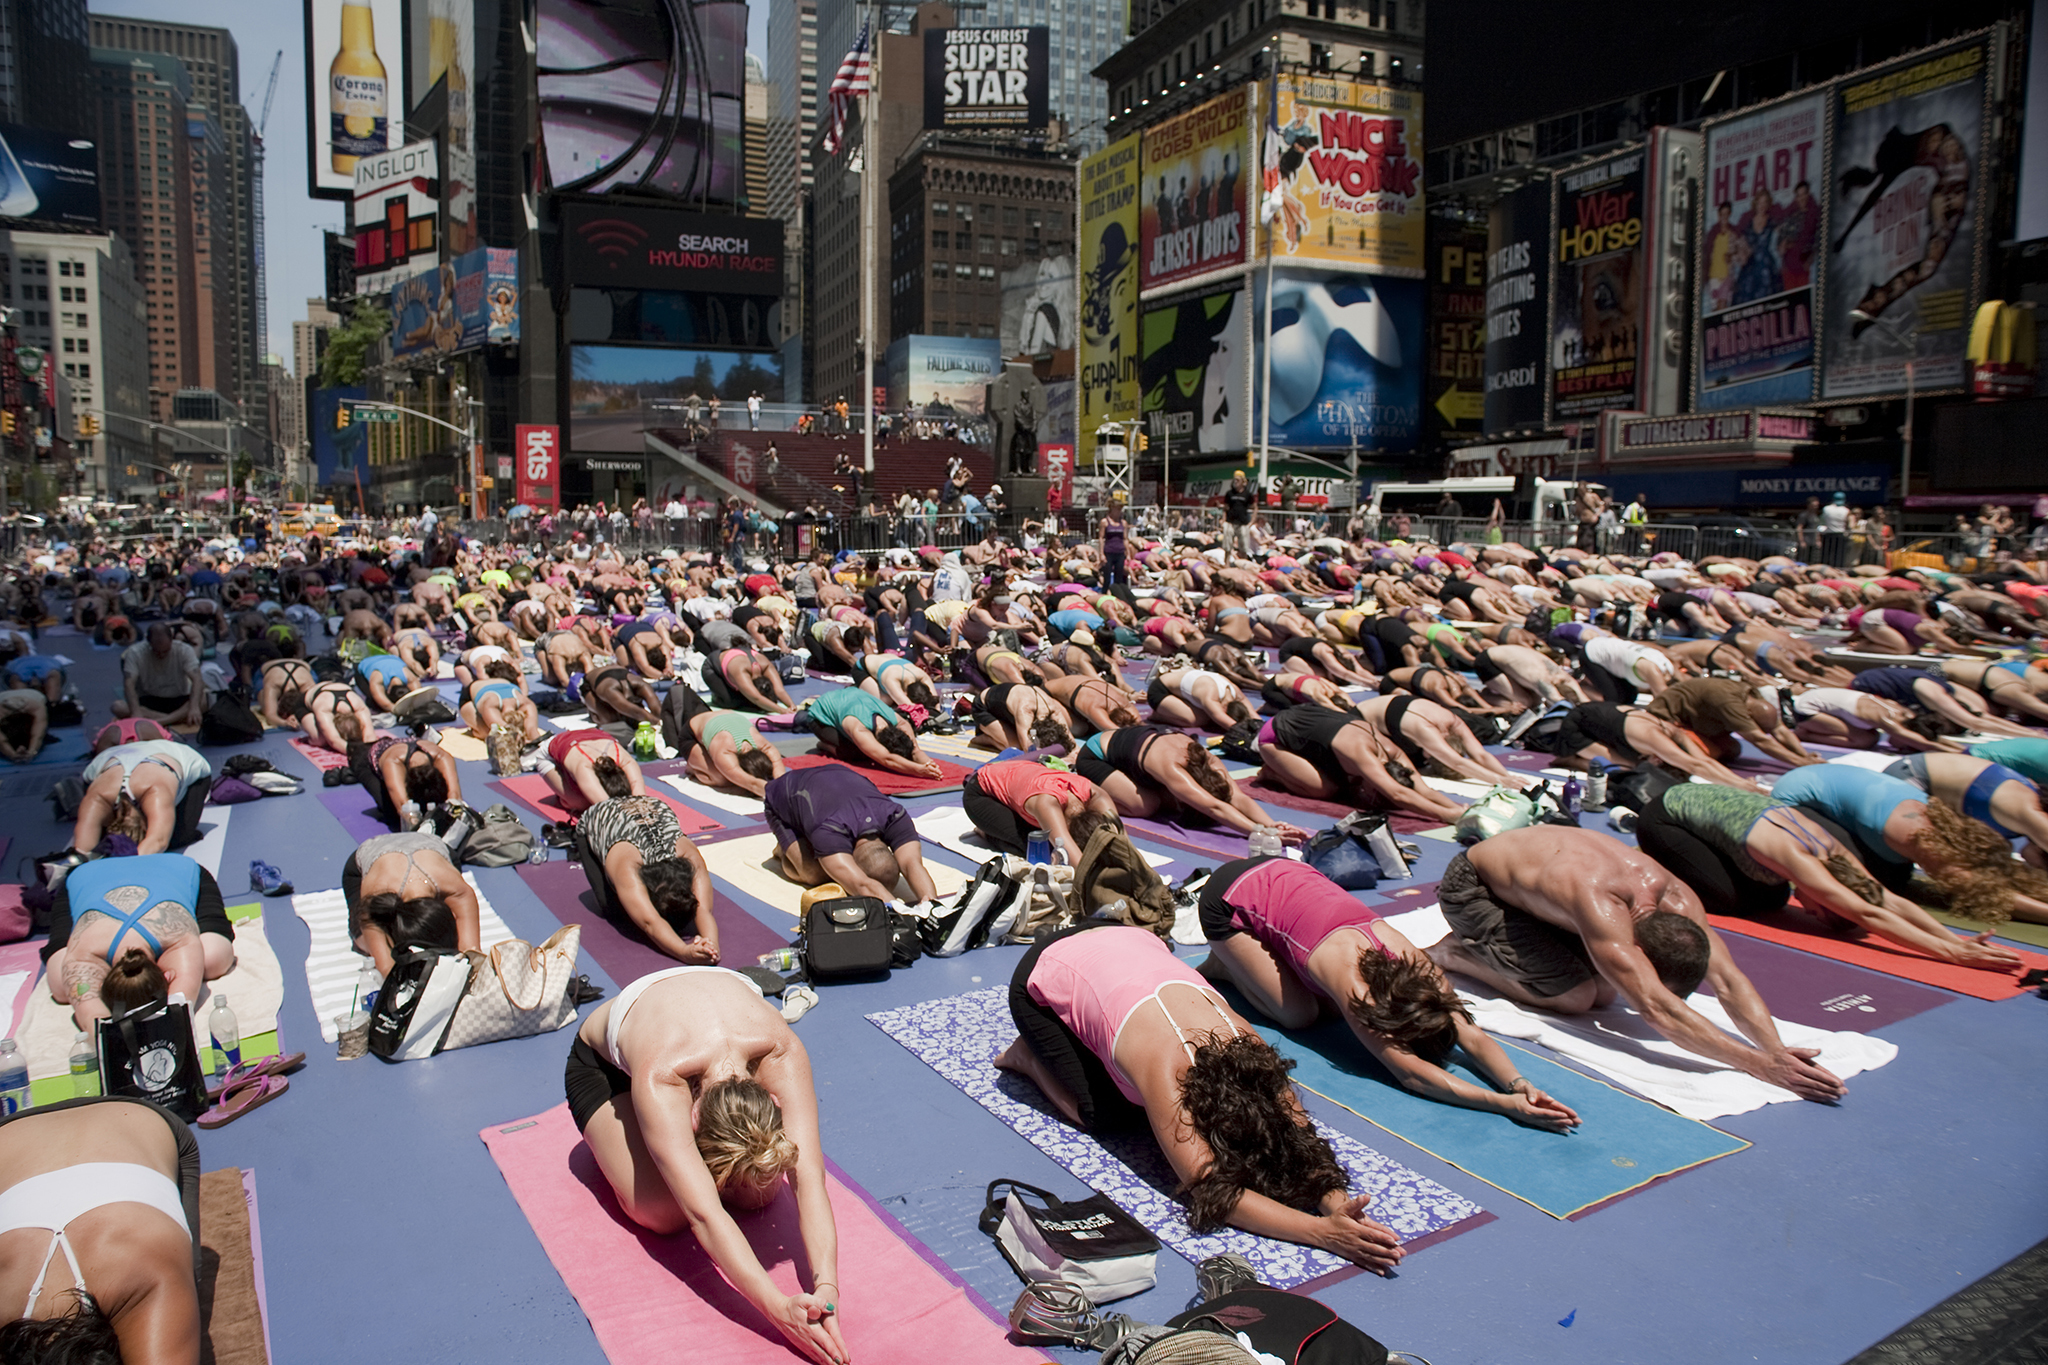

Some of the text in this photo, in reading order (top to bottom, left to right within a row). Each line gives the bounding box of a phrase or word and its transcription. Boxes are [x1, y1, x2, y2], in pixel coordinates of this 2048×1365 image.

[944, 28, 1029, 44] JESUS CHRIST
[944, 43, 1029, 71] SUPER
[334, 75, 384, 96] Corona
[944, 70, 1029, 106] STAR
[1151, 91, 1246, 146] THE CROWD
[1151, 111, 1244, 163] GOES WILD!
[1321, 111, 1408, 157] NICE
[356, 148, 429, 184] INGLOT
[1309, 148, 1421, 199] WORK
[1713, 141, 1814, 207] HEART
[1320, 191, 1331, 207] If
[1333, 195, 1353, 211] You
[1354, 201, 1375, 214] Can
[1578, 190, 1635, 231] War
[678, 233, 749, 254] SEARCH
[1150, 222, 1200, 277] JERSEY
[1202, 210, 1241, 262] BOYS
[1559, 216, 1642, 263] Horse
[1668, 147, 1690, 354] PALACE
[649, 249, 776, 273] HYUNDAI RACE
[1705, 303, 1810, 361] PRISCILLA
[926, 355, 992, 375] FALLING SKIES
[1081, 334, 1137, 403] CHAPLIN
[1316, 401, 1416, 425] PHANTOM
[1322, 423, 1408, 438] OF THE OPERA
[1629, 415, 1747, 445] OUTRAGEOUS FUN!
[527, 430, 554, 481] tkts
[586, 458, 642, 471] SHERWOOD
[1272, 476, 1333, 495] sarro
[1740, 475, 1882, 494] MONEY EXCHANGE
[1822, 994, 1874, 1013] ATHLETA
[149, 1040, 167, 1049] YOGA
